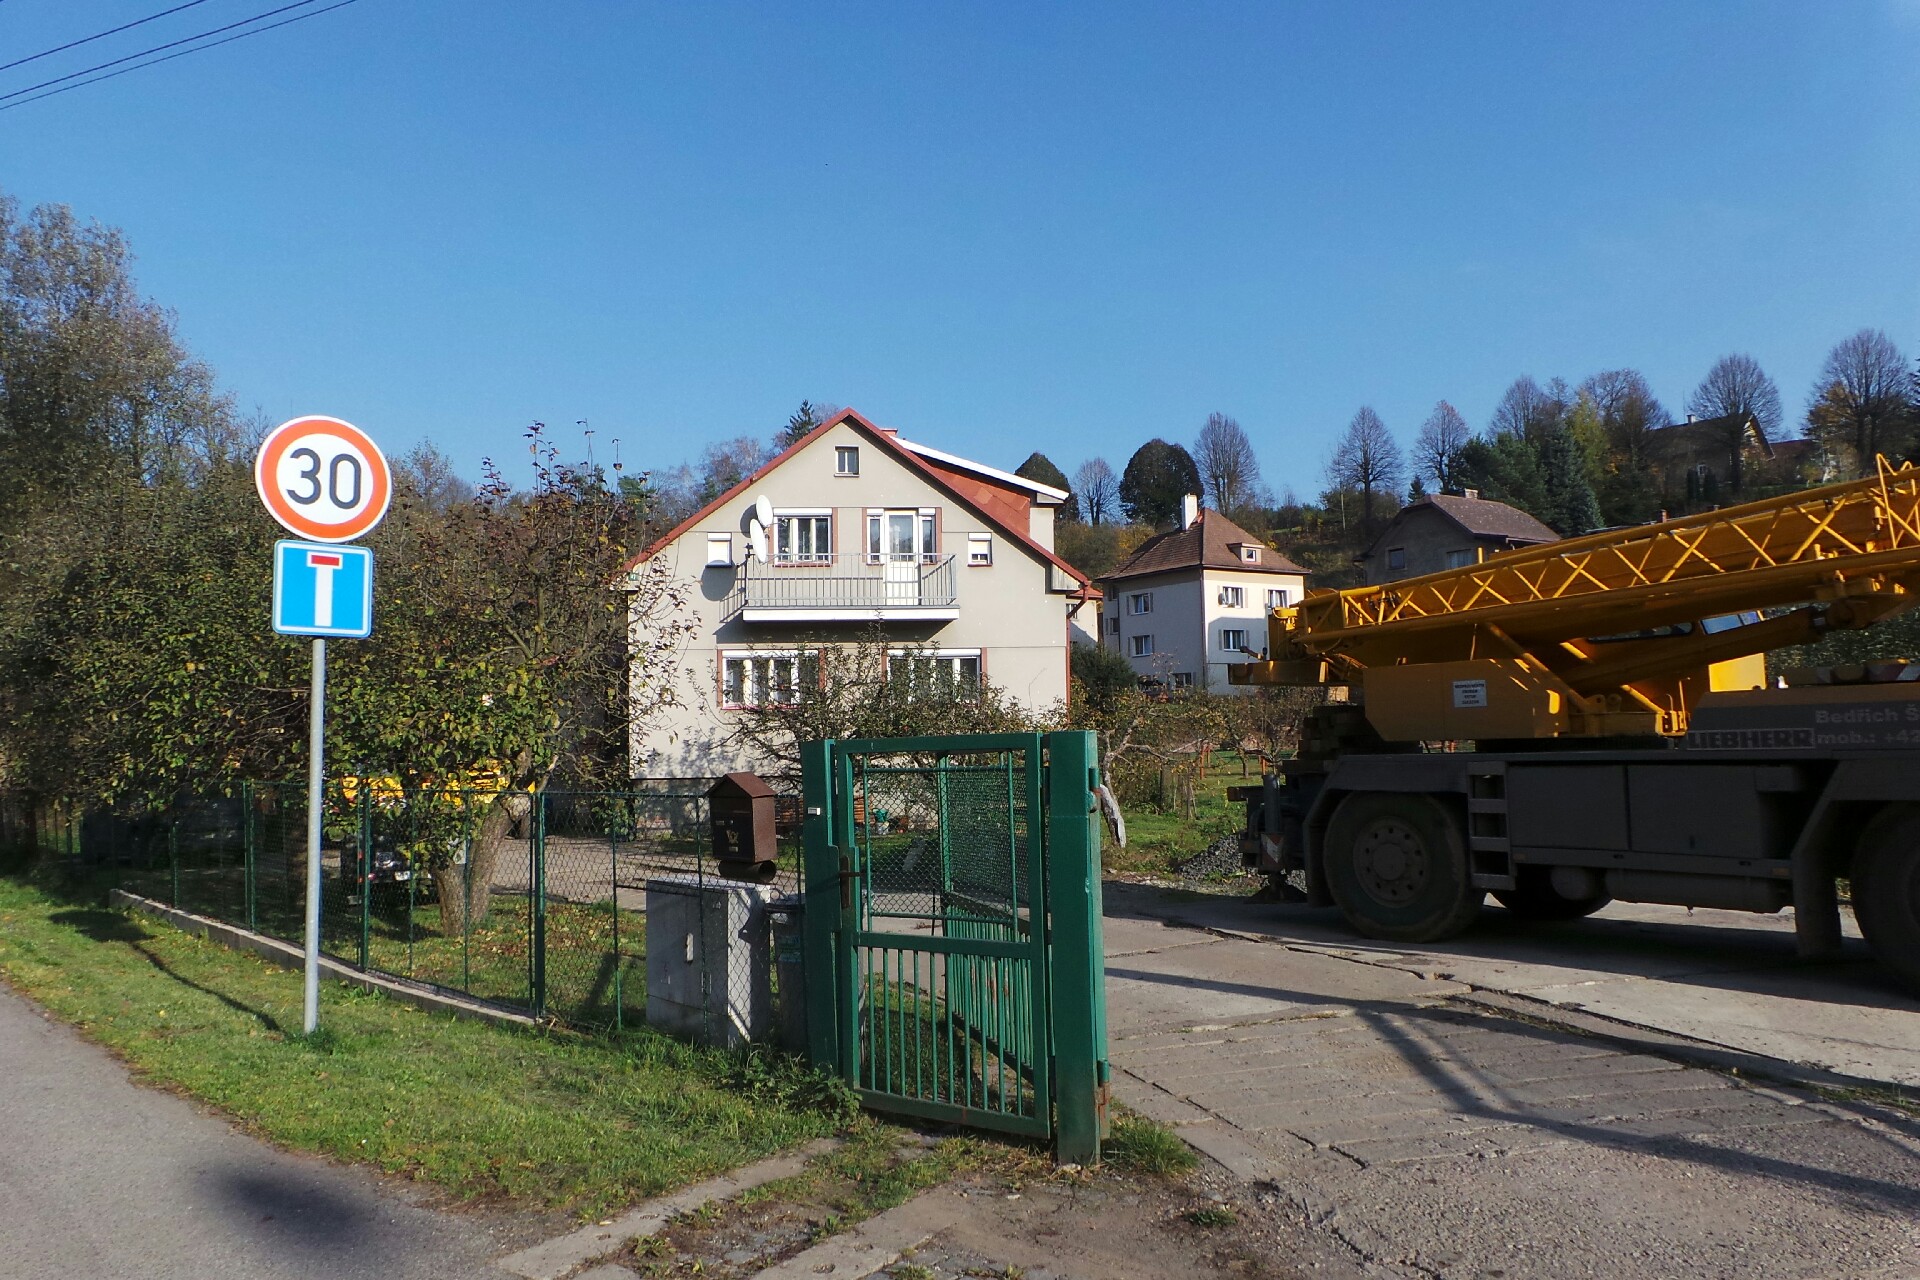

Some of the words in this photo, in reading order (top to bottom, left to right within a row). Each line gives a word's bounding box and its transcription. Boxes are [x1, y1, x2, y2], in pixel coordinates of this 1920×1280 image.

[287, 447, 361, 509] 30
[1815, 708, 1898, 723] Bedřich
[1688, 729, 1814, 749] LIEBHERR
